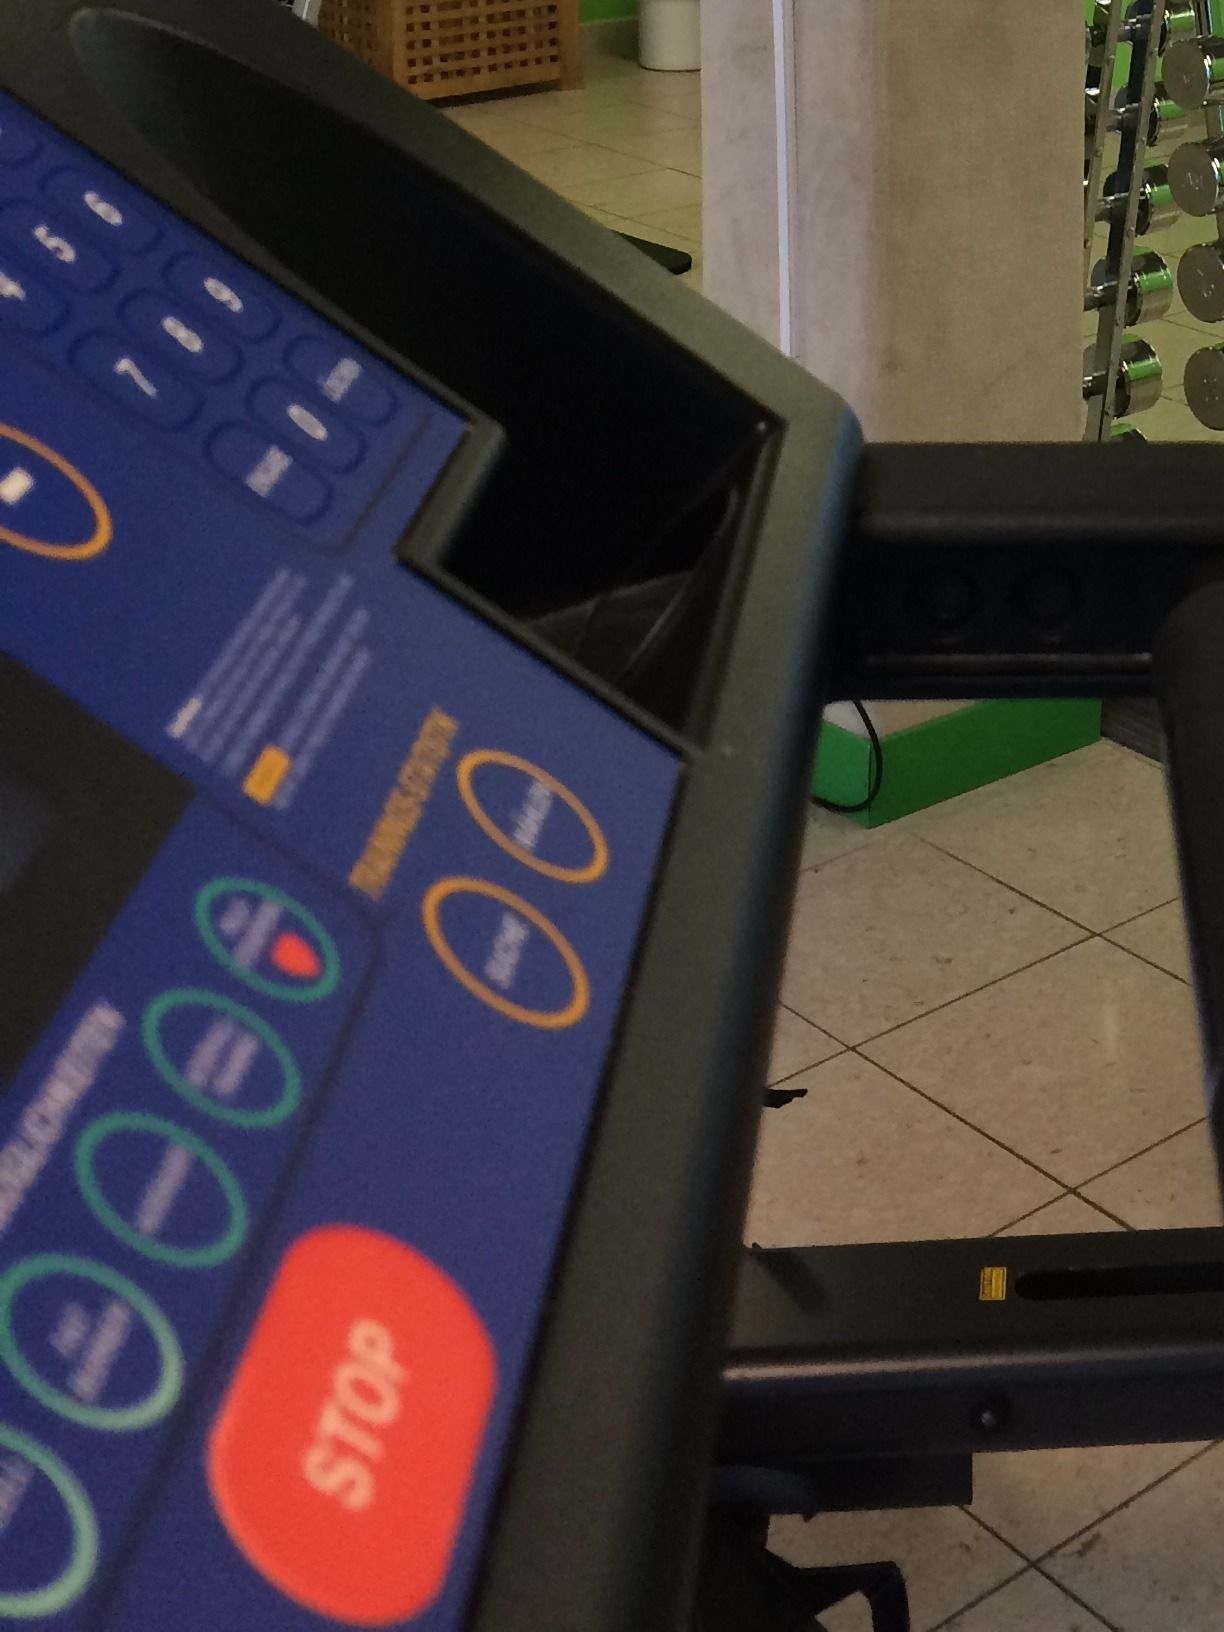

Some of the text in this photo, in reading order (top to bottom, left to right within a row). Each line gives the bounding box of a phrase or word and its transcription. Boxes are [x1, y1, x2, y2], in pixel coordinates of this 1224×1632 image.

[34, 224, 76, 263] 5
[115, 358, 158, 398] 7
[303, 1317, 411, 1511] STOP
